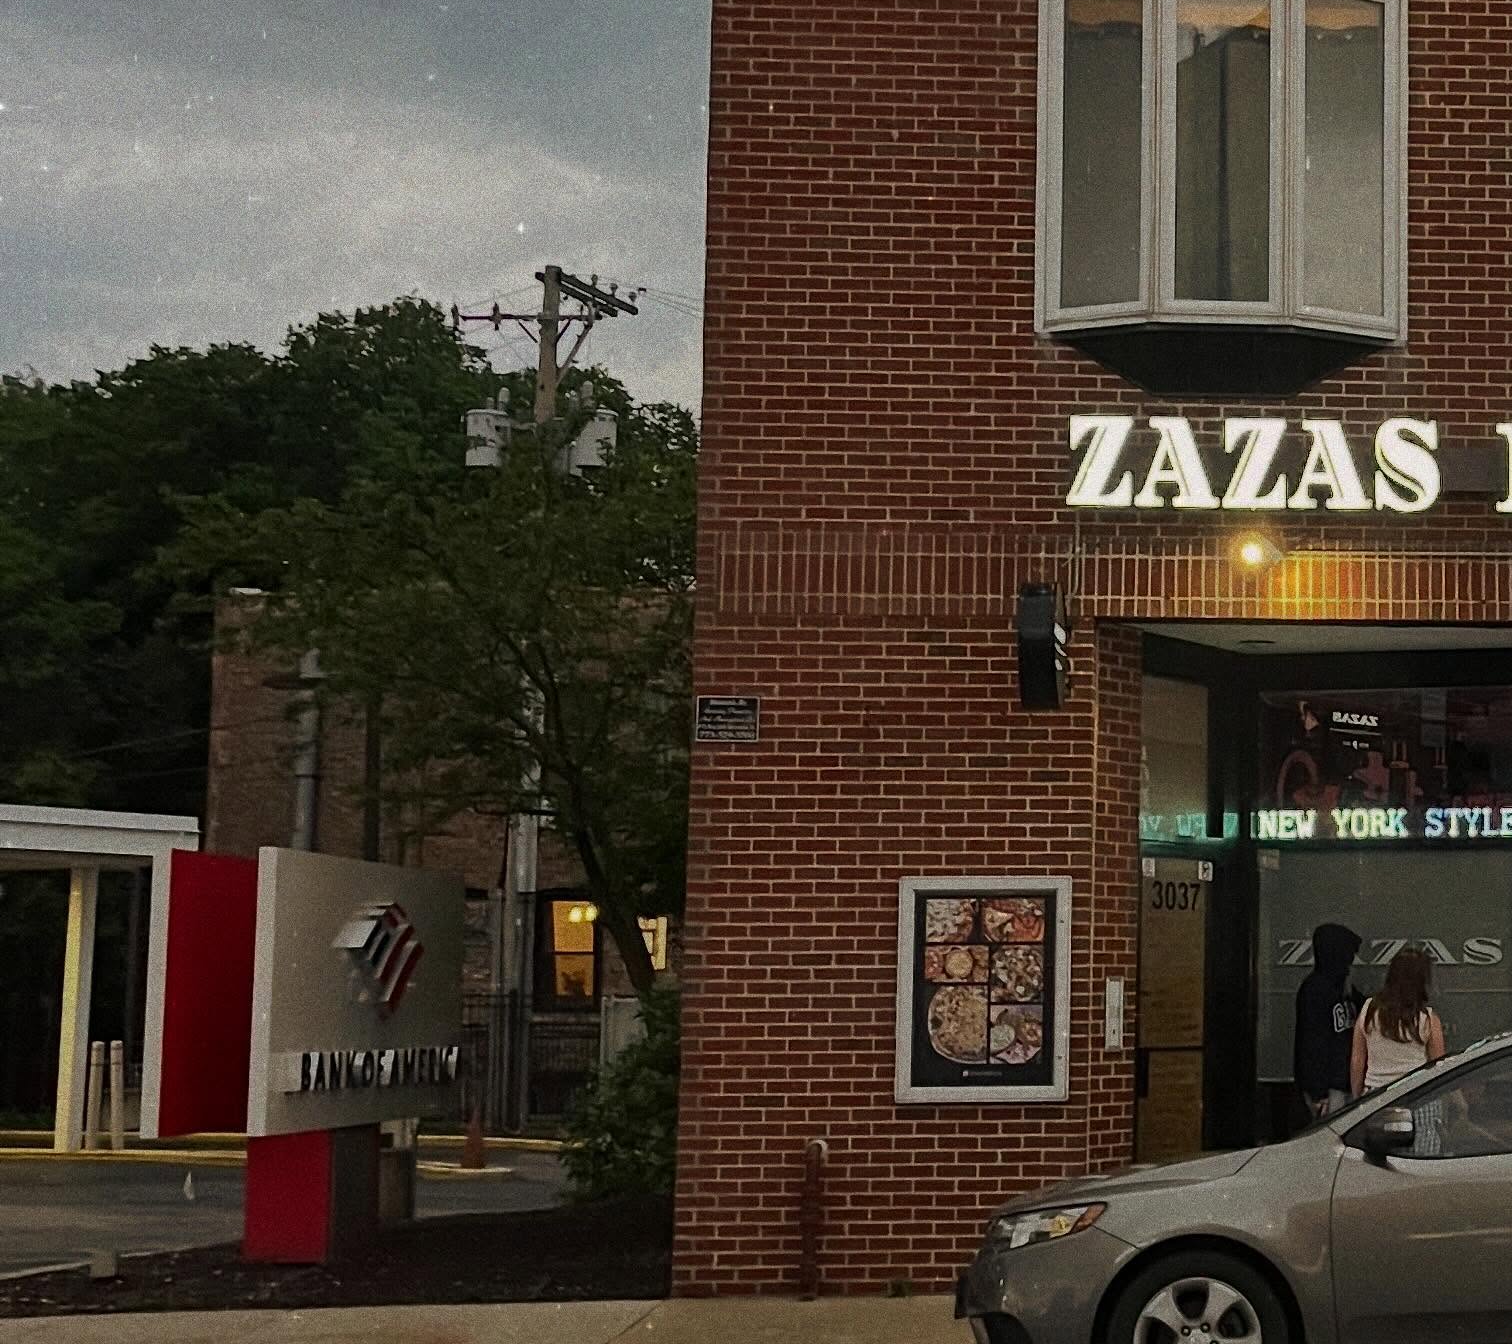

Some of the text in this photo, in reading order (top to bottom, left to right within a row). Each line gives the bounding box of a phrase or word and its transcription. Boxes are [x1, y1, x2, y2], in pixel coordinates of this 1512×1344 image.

[1066, 414, 1441, 513] ZAZAS
[1257, 809, 1317, 840] NEW
[1330, 808, 1410, 839] YORK
[1152, 881, 1200, 911] 3037
[1277, 937, 1503, 966] ZZAS
